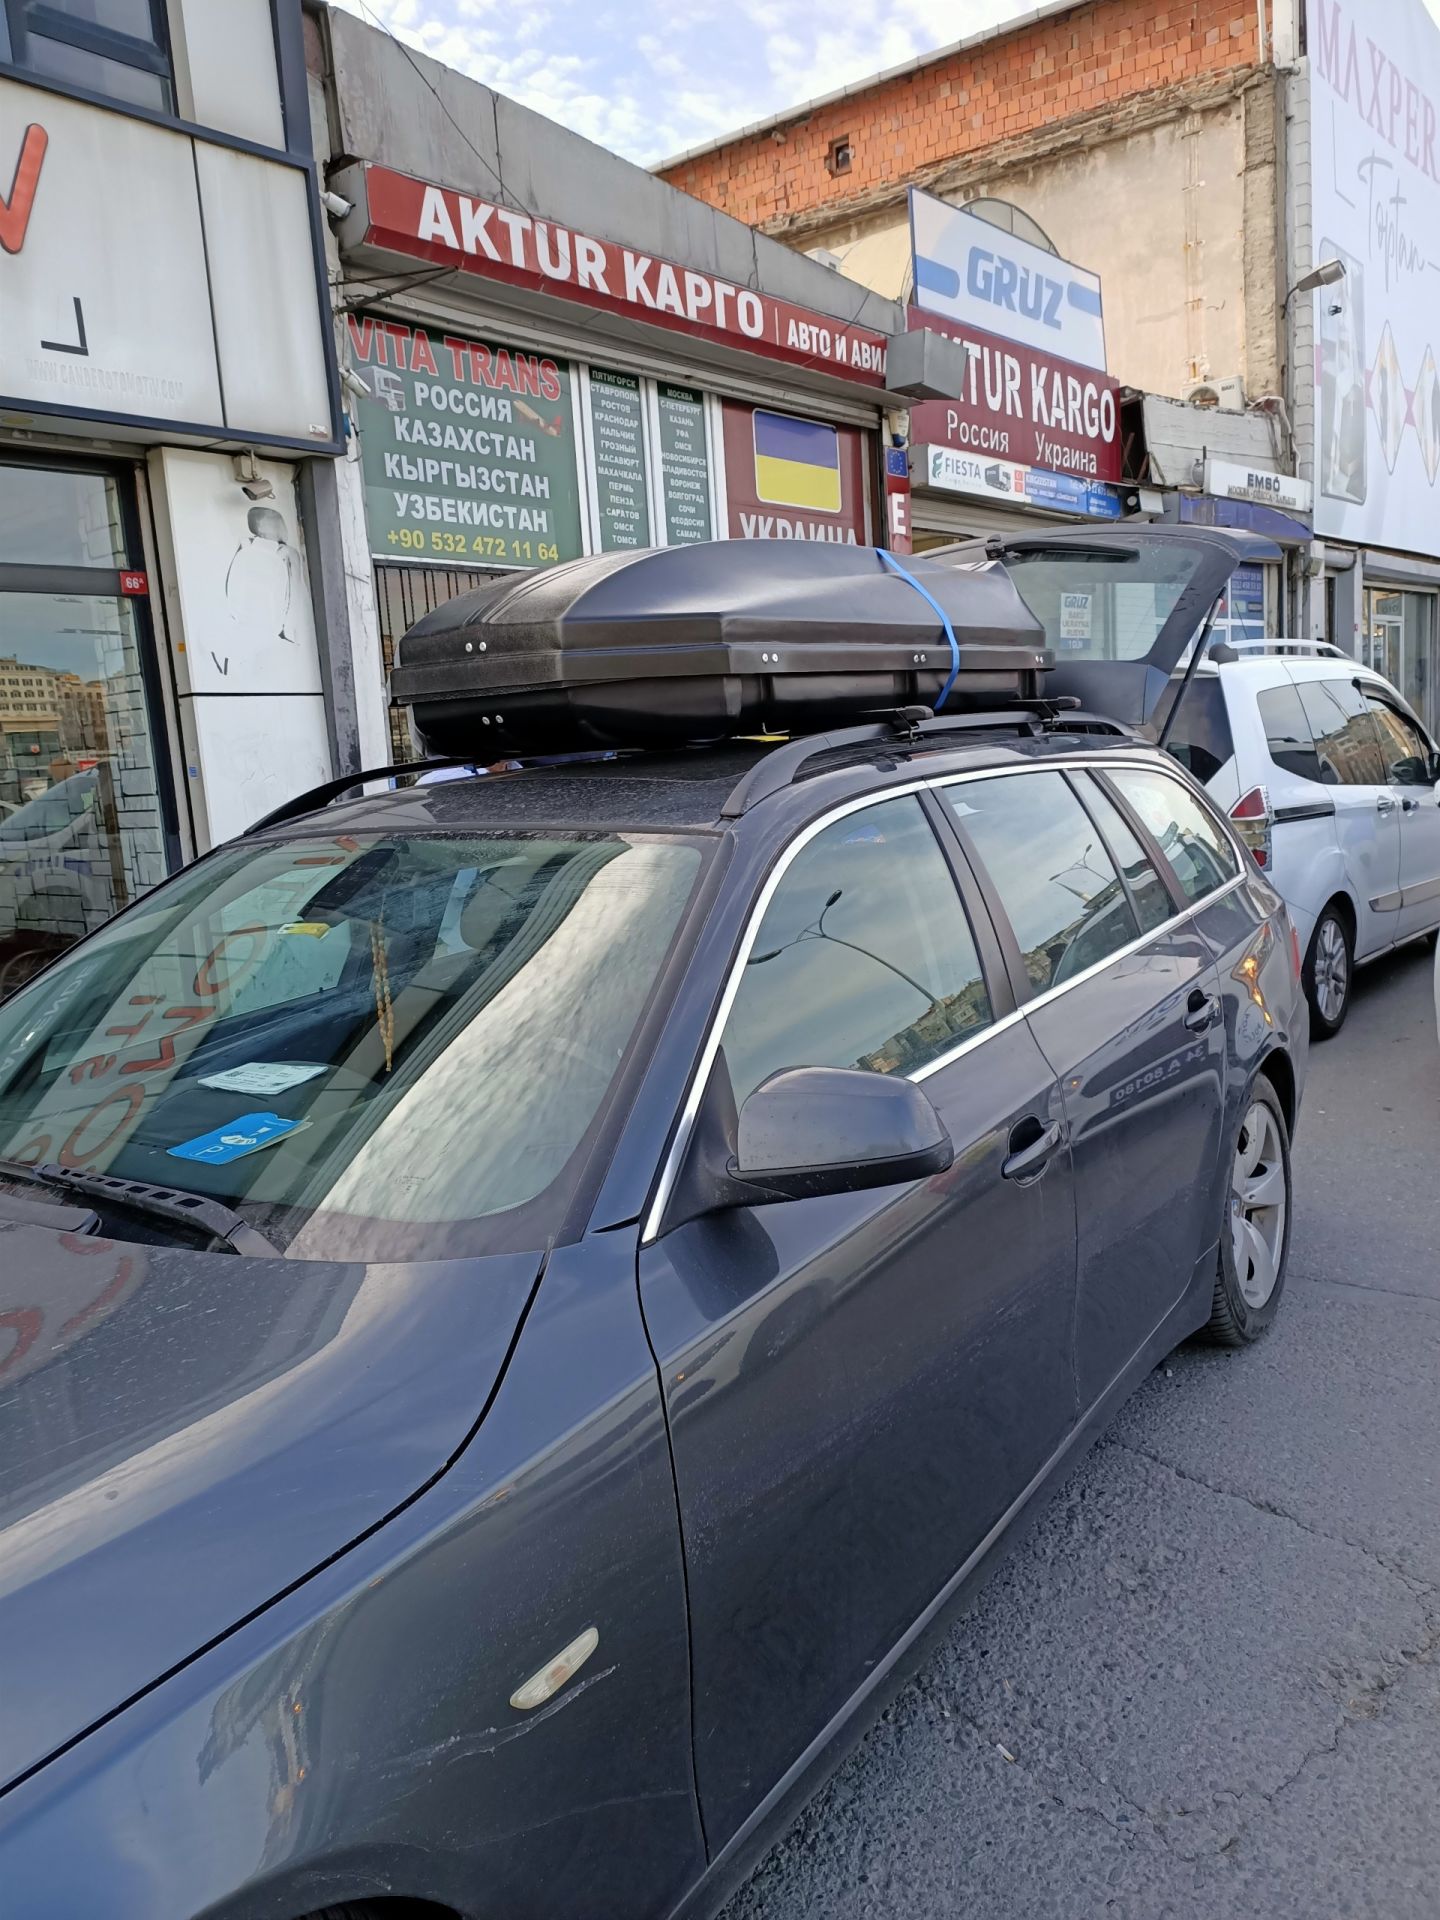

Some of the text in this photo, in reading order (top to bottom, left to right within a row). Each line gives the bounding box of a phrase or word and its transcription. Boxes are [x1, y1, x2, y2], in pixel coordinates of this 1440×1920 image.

[418, 186, 764, 338] AKTUR КАРГО
[788, 319, 831, 357] АВТО
[835, 333, 847, 362] И
[444, 336, 560, 400] TRANS
[592, 370, 636, 388] ПЯТИГОРСК
[591, 384, 639, 402] СТАВРОПОЛЬ
[667, 388, 693, 402] МОСКВА
[414, 381, 512, 423] РОССИЯ
[601, 400, 630, 413] РОСТОВ
[1031, 363, 1115, 443] KARGO
[595, 412, 638, 428] КРАСНОДАР
[669, 415, 694, 427] КАЗАНЬ
[394, 416, 536, 462] КАЗАХСТАН
[600, 427, 635, 440] НАЛЬЧИК
[676, 429, 689, 438] УФА
[601, 440, 636, 454] ГРОЗНЫЙ
[675, 441, 692, 451] ОМСК
[947, 410, 1096, 474] Россия Украина
[600, 453, 639, 468] ХАСАВЮРТ
[598, 467, 642, 481] МАХАЧКАЛА
[945, 457, 981, 479] FIESTA
[384, 453, 550, 499] КЫРГЫЗСТАН
[609, 482, 634, 493] ПЕРМЬ
[670, 478, 700, 490] ВОРОНЕЖ
[610, 495, 634, 506] ПЕНЗА
[668, 491, 705, 504] ВОЛГОГРАД
[393, 492, 548, 533] УЗБЕКИСТАН
[606, 508, 640, 520] САРАТОВ
[678, 504, 696, 514] СОЧИ
[614, 522, 634, 532] ОМСК
[671, 517, 705, 527] ФЕОДОСИЯ
[612, 535, 637, 545] ТОМСК
[676, 529, 701, 539] САМАРА
[387, 529, 558, 560] +90 532 472 11 64
